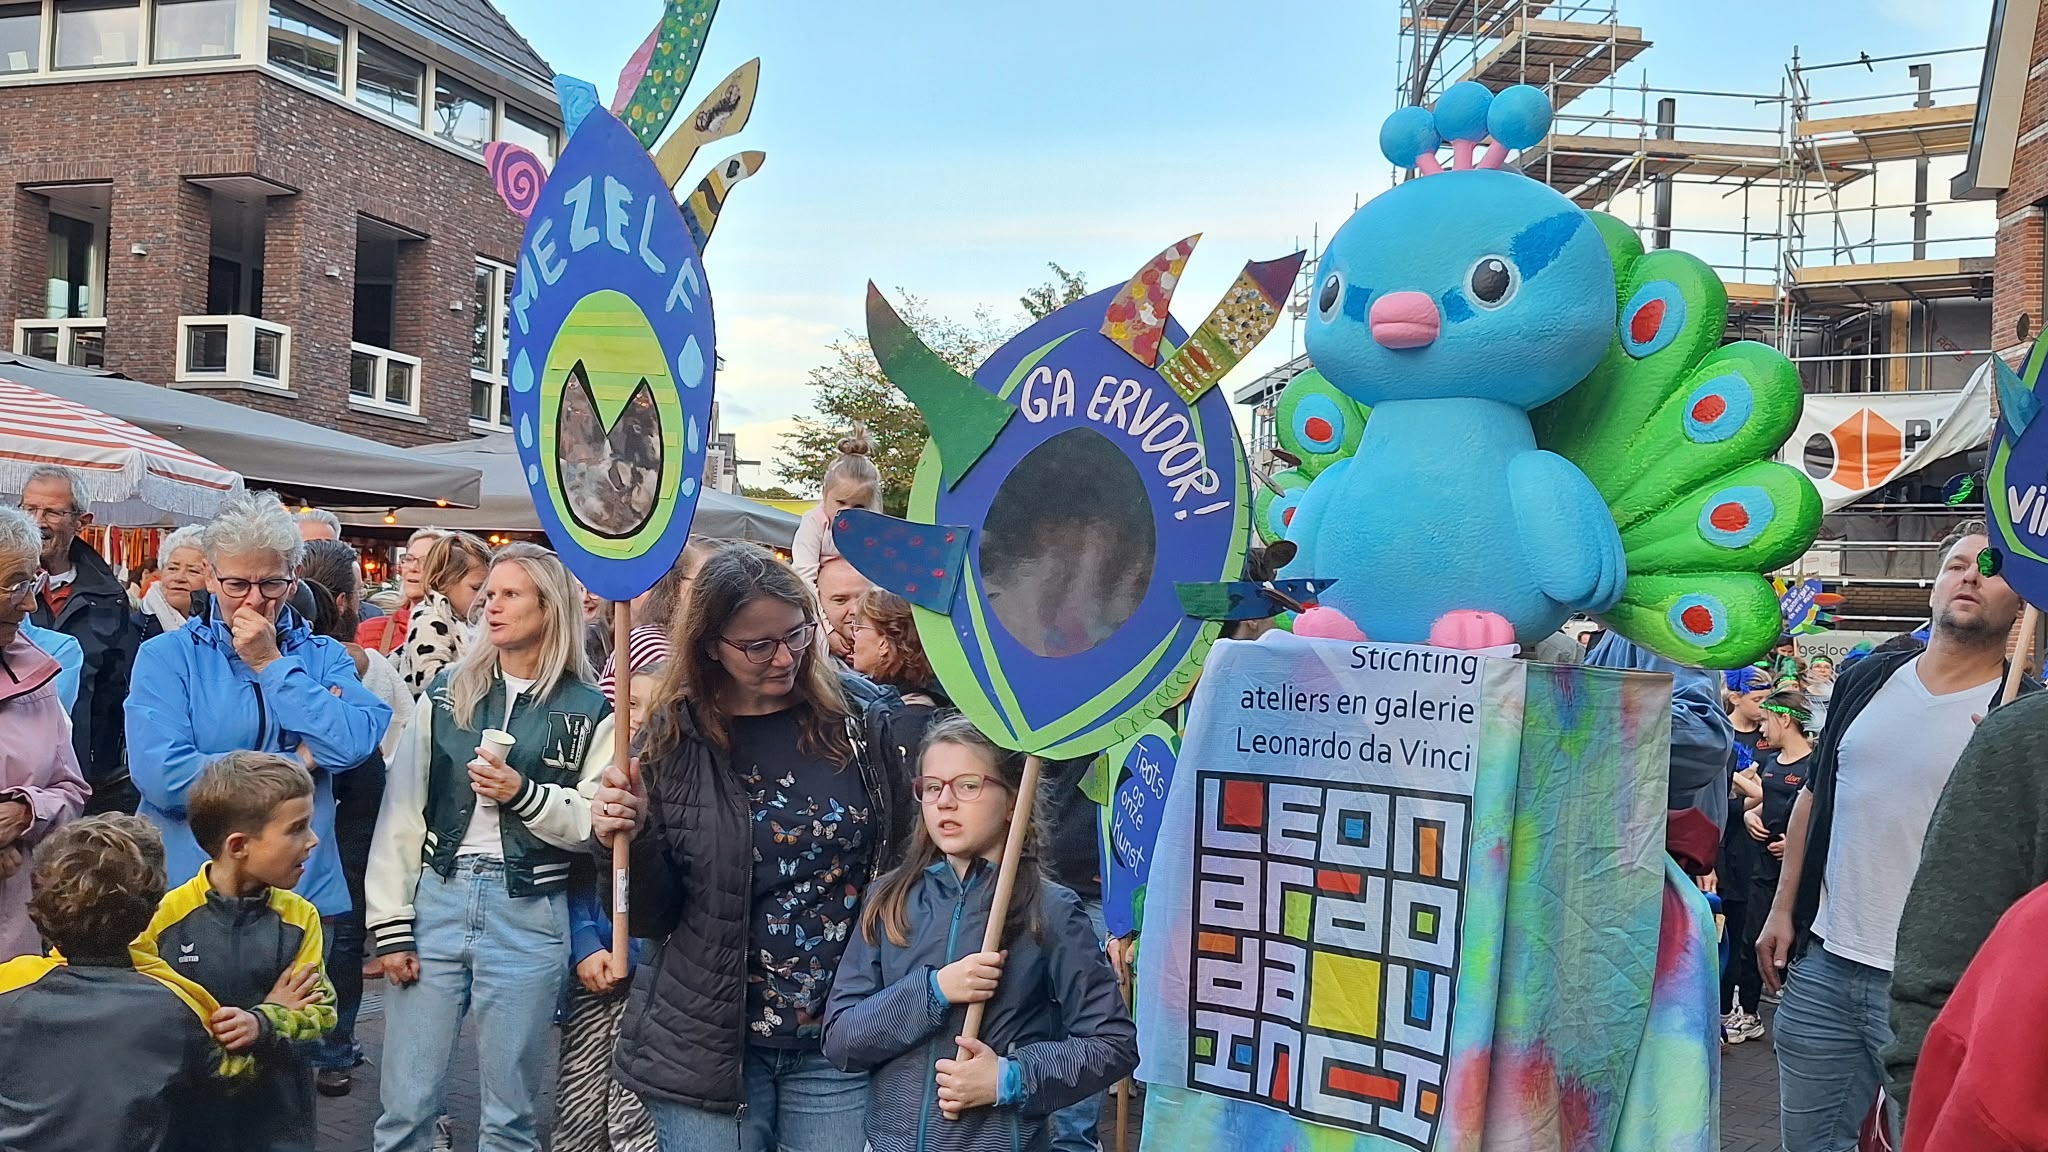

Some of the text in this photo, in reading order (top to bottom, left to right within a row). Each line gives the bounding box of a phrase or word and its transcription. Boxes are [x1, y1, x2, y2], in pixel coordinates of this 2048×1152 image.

[512, 175, 700, 335] MEZELF
[1021, 366, 1231, 521] GA ERVOOR!
[1351, 645, 1478, 684] Stichting
[1241, 684, 1474, 725] ateliers en galerie
[1237, 727, 1471, 771] Leonardo da Vinci
[1121, 790, 1144, 831] onze
[1133, 785, 1145, 808] op
